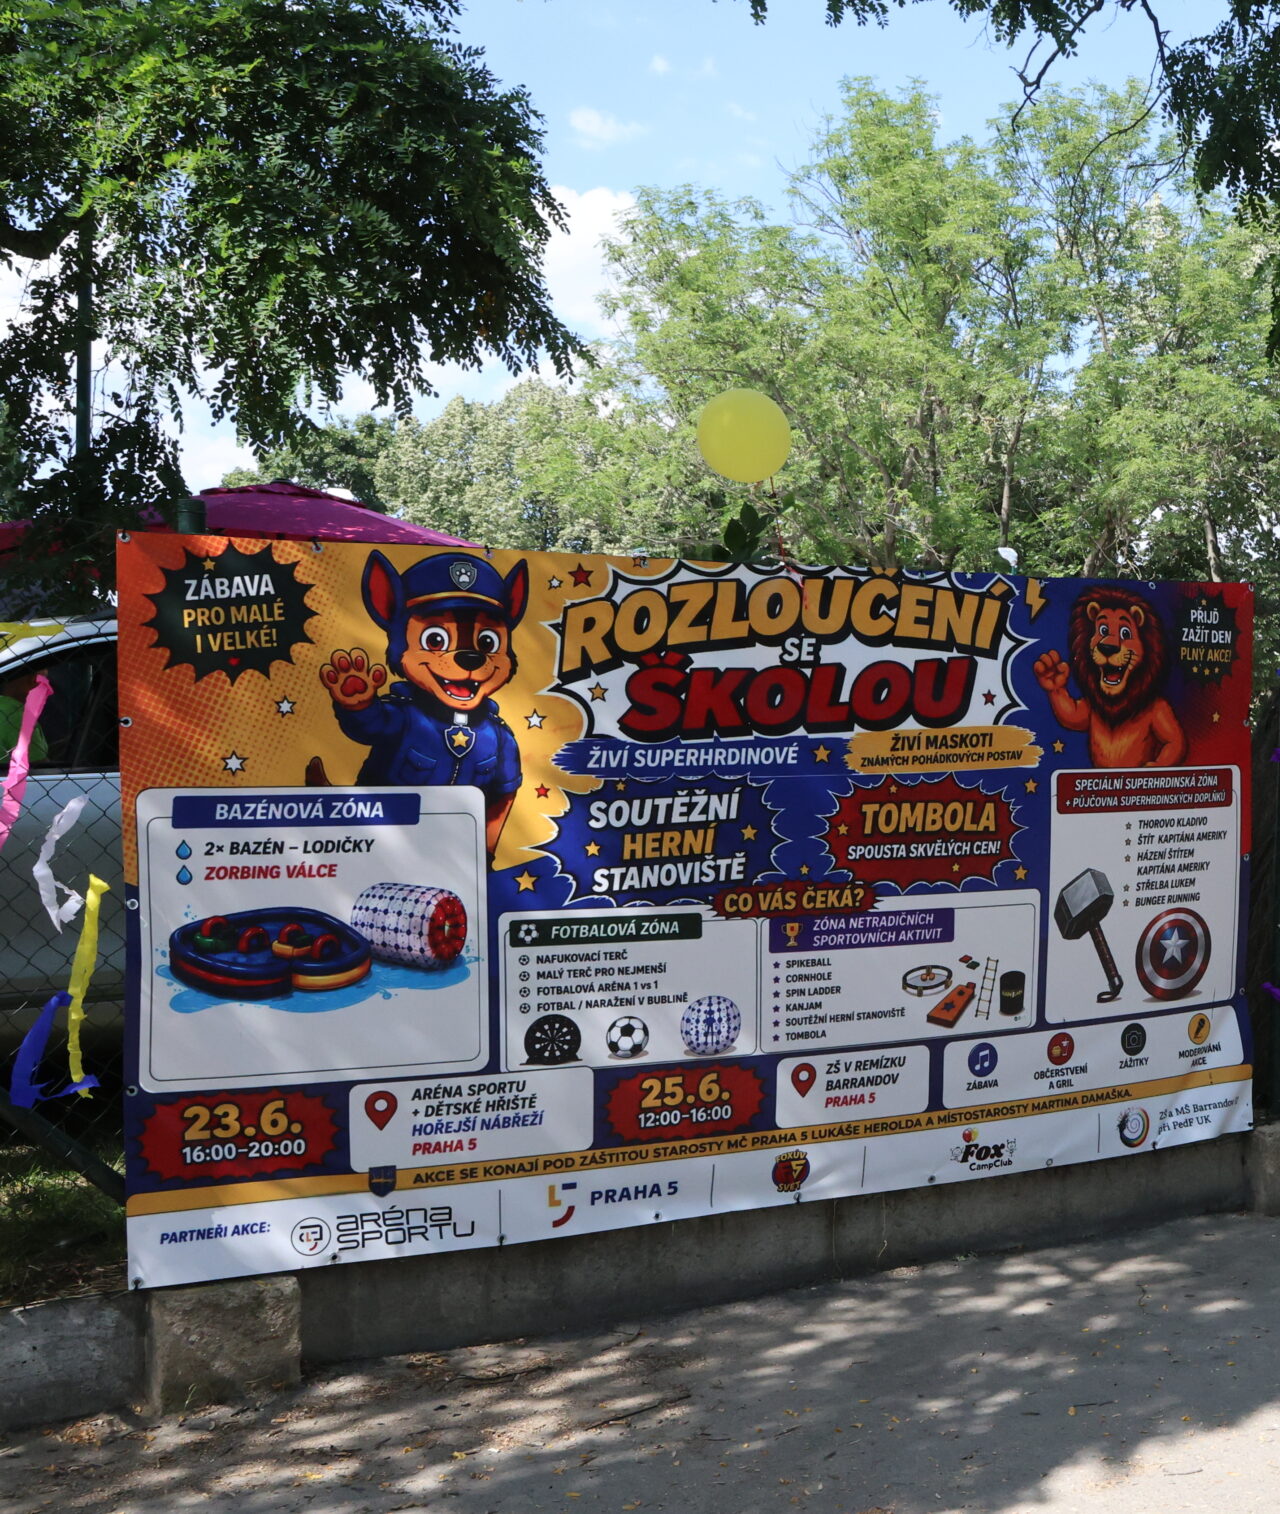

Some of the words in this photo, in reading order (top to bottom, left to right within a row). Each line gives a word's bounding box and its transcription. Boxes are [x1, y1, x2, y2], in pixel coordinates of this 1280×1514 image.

[184, 572, 275, 601] ZÁBAVA
[183, 606, 226, 628] PRO
[230, 598, 285, 624] MALÉ
[561, 567, 1010, 672] ROZLOUČENÍ
[1190, 608, 1219, 624] PŘIJĎ
[195, 633, 202, 653] I
[206, 622, 278, 651] VELKÉ!
[1182, 627, 1209, 643] ZAŽÍT
[1211, 630, 1232, 644] DEN
[782, 637, 816, 663] SE
[1180, 645, 1206, 661] PLNÝ
[1207, 649, 1232, 663] AKCE!
[622, 652, 974, 731] ŠKOLOU
[890, 729, 922, 751] ŽIVÍ
[925, 732, 994, 750] MASKOTI
[587, 744, 630, 769] ŽIVÍ
[633, 741, 799, 768] SUPERHRDINOVÉ
[860, 751, 909, 768] ZNÁMÝCH
[911, 749, 985, 766] POHÁDKOVÝCH
[986, 748, 1023, 763] POSTAV
[1075, 776, 1124, 791] SPECIÁLNÍ
[1125, 775, 1196, 790] SUPERHRDINSKÁ
[1197, 775, 1218, 787] ZÓNA
[215, 797, 324, 821] BAZÉNOVÁ
[330, 796, 384, 819] ZÓNA
[588, 788, 741, 829] SOUTĚŽNÍ
[1072, 794, 1118, 808] PŮJČOVNA
[1120, 792, 1193, 806] SUPERHRDINSKÝCH
[1194, 790, 1226, 803] DOPLŇKŮ
[861, 801, 996, 834] TOMBOLA
[1138, 819, 1176, 829] THOROVO
[1177, 816, 1208, 828] KLADIVO
[229, 835, 284, 856] BAZÉN
[303, 832, 375, 854] LODIČKY
[622, 824, 718, 861] HERNÍ
[1137, 833, 1155, 845] ŠTÍT
[1158, 831, 1195, 844] KAPITÁNA
[1196, 830, 1228, 842] AMERIKY
[847, 843, 905, 861] SPOUSTA
[908, 839, 970, 858] SKVĚLÝCH
[972, 839, 1001, 855] CEN!
[1137, 849, 1167, 861] HÁZENÍ
[1168, 848, 1195, 859] ŠTÍTEM
[204, 864, 281, 881] ZORBING
[286, 858, 338, 879] VÁLCE
[591, 852, 746, 894] STANOVIŠTĚ
[1136, 863, 1176, 876] KAPITÁNA
[1177, 861, 1211, 874] AMERIKY
[1135, 879, 1170, 891] STŘELBA
[1170, 878, 1196, 889] LUKEM
[724, 892, 753, 913] CO
[758, 888, 797, 911] VÁS
[803, 886, 865, 910] ČEKÁ?
[1135, 895, 1166, 907] BUNGEE
[1167, 892, 1200, 905] RUNNING
[551, 921, 636, 939] FOTBALOVÁ
[640, 920, 680, 935] ZÓNA
[813, 916, 847, 931] ZÓNA
[849, 912, 934, 930] NETRADIČNÍCH
[813, 929, 897, 947] SPORTOVNÍCH
[899, 928, 943, 942] AKTIVIT
[536, 951, 601, 965] NAFUKOVACÍ
[603, 949, 628, 961] TERČ
[785, 958, 832, 969] SPIKEBALL
[536, 967, 565, 980] MALÝ
[568, 965, 592, 979] TERČ
[594, 966, 615, 977] PRO
[617, 962, 667, 976] NEJMENŠÍ
[785, 972, 833, 983] CORNHOLE
[536, 983, 596, 997] FOTBALOVÁ
[597, 980, 632, 993] ARÉNA
[633, 981, 638, 991] 1
[654, 980, 658, 990] 1
[785, 987, 806, 997] SPIN
[807, 986, 841, 996] LADDER
[537, 1001, 576, 1013] FOTBAL
[577, 1000, 584, 1010] /
[585, 995, 636, 1009] NARAŽENÍ
[637, 996, 645, 1005] V
[647, 992, 689, 1005] BUBLINĚ
[785, 1001, 822, 1012] KANJAM
[785, 1014, 828, 1027] SOUTĚŽNÍ
[829, 1010, 855, 1023] HERNÍ
[856, 1007, 906, 1021] STANOVIŠTĚ
[785, 1030, 827, 1041] TOMBOLA
[825, 1061, 841, 1075] ZŠ
[844, 1061, 853, 1071] V
[855, 1055, 907, 1071] REMÍZKU
[1033, 1063, 1088, 1080] OBČERSTVENÍ
[1119, 1057, 1149, 1069] ZÁŽITKY
[411, 1085, 464, 1101] ARÉNA
[467, 1080, 526, 1096] SPORTU
[641, 1072, 731, 1109] 25.6.
[825, 1073, 900, 1091] BARRANDOV
[966, 1078, 999, 1091] ZÁBAVA
[1048, 1081, 1055, 1090] A
[1057, 1078, 1074, 1089] GRIL
[412, 1109, 419, 1117] +
[424, 1098, 482, 1117] DĚTSKÉ
[485, 1093, 538, 1113] HŘIŠTĚ
[824, 1094, 866, 1108] PRAHA
[868, 1092, 876, 1103] 5
[1175, 1104, 1191, 1115] MŠ
[183, 1099, 303, 1141] 23.6.
[411, 1117, 477, 1137] HOŘEJŠÍ
[480, 1110, 545, 1131] NÁBŘEŽÍ
[1158, 1122, 1171, 1135] při
[1172, 1118, 1194, 1130] PedF
[1195, 1115, 1212, 1125] UK
[411, 1140, 464, 1156] PRAHA
[467, 1138, 477, 1151] 5
[413, 1170, 455, 1184] AKCE
[459, 1167, 478, 1180] SE
[483, 1159, 539, 1177] KONAJÍ
[543, 1157, 575, 1171] POD
[579, 1149, 649, 1167] ZÁŠTITOU
[653, 1141, 724, 1159] STAROSTY
[727, 1135, 747, 1150] MČ
[751, 1133, 797, 1147] PRAHA
[800, 1130, 808, 1141] 5
[811, 1122, 860, 1140] LUKÁŠE
[864, 1118, 923, 1134] HEROLDA
[925, 1116, 935, 1126] A
[937, 1103, 1029, 1124] MÍSTOSTAROSTY
[1032, 1096, 1079, 1112] MARTINA
[969, 1158, 1013, 1171] CampClub
[590, 1183, 662, 1206] PRAHA
[667, 1181, 678, 1195] 5
[159, 1224, 227, 1244] PARTNEŘI
[230, 1222, 271, 1236] AKCE:
[337, 1220, 475, 1251] SPORTU
